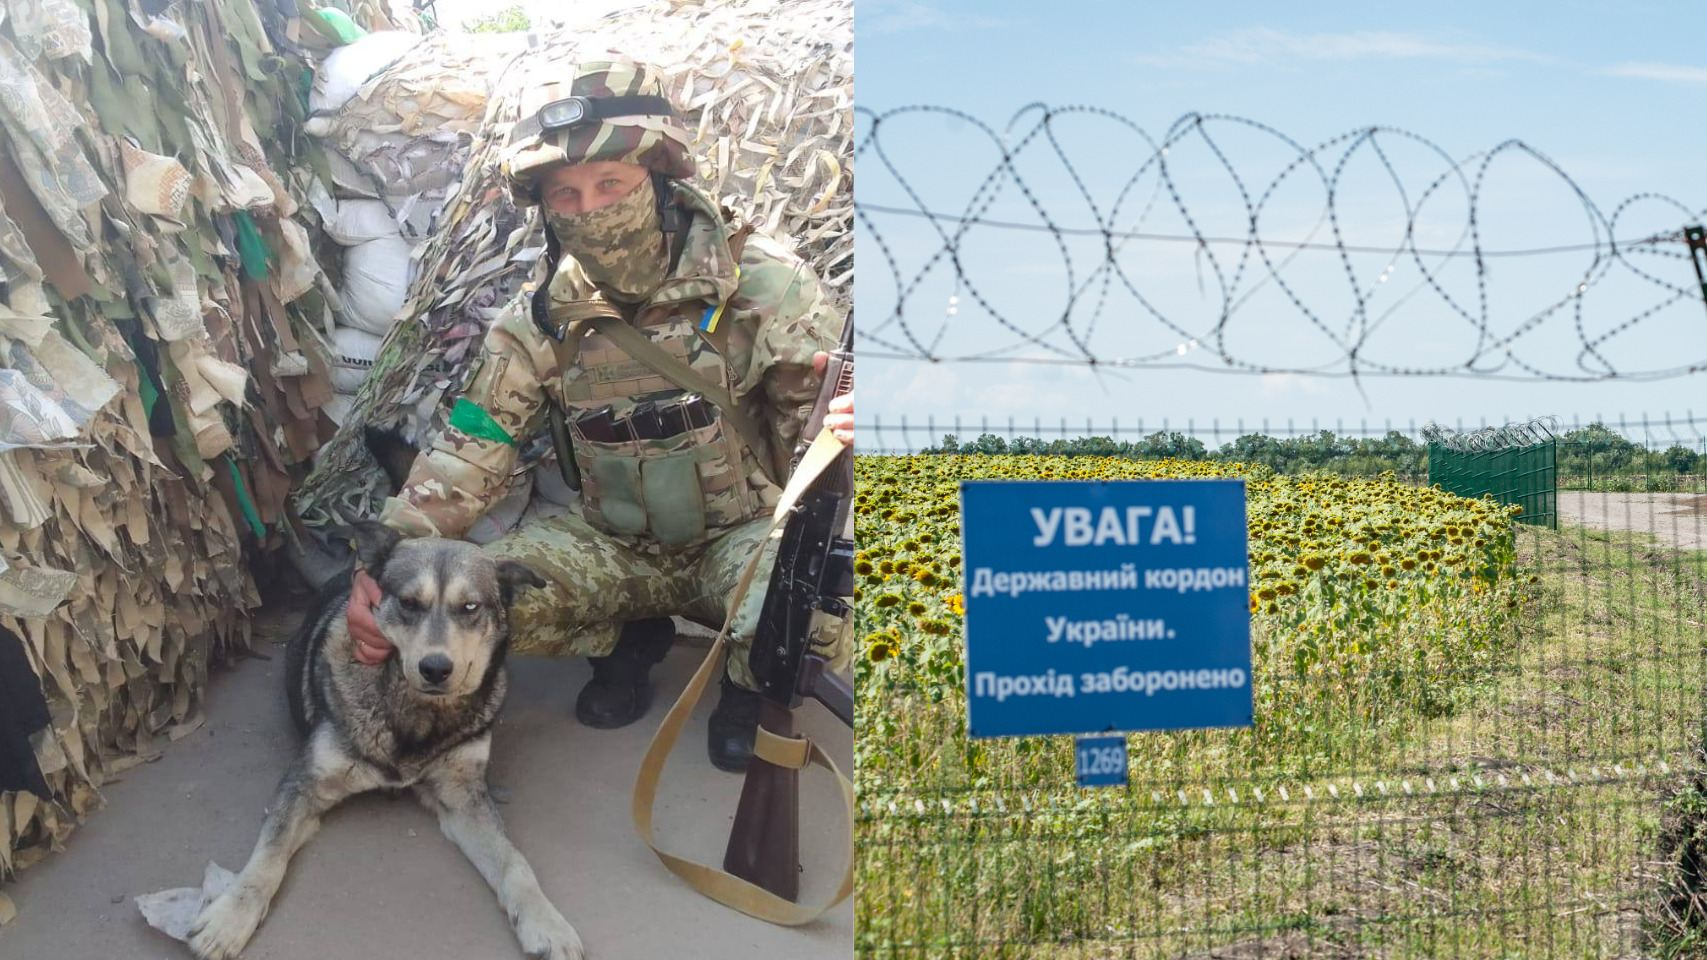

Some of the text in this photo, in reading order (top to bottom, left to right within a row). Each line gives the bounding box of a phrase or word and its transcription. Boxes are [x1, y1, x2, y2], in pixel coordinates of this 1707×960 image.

[1030, 505, 1197, 547] УВАГА!
[971, 563, 1246, 598] Державний кордон
[1045, 614, 1177, 648] України.
[975, 666, 1246, 702] Прохід заборонено
[1079, 747, 1124, 775] 1269
